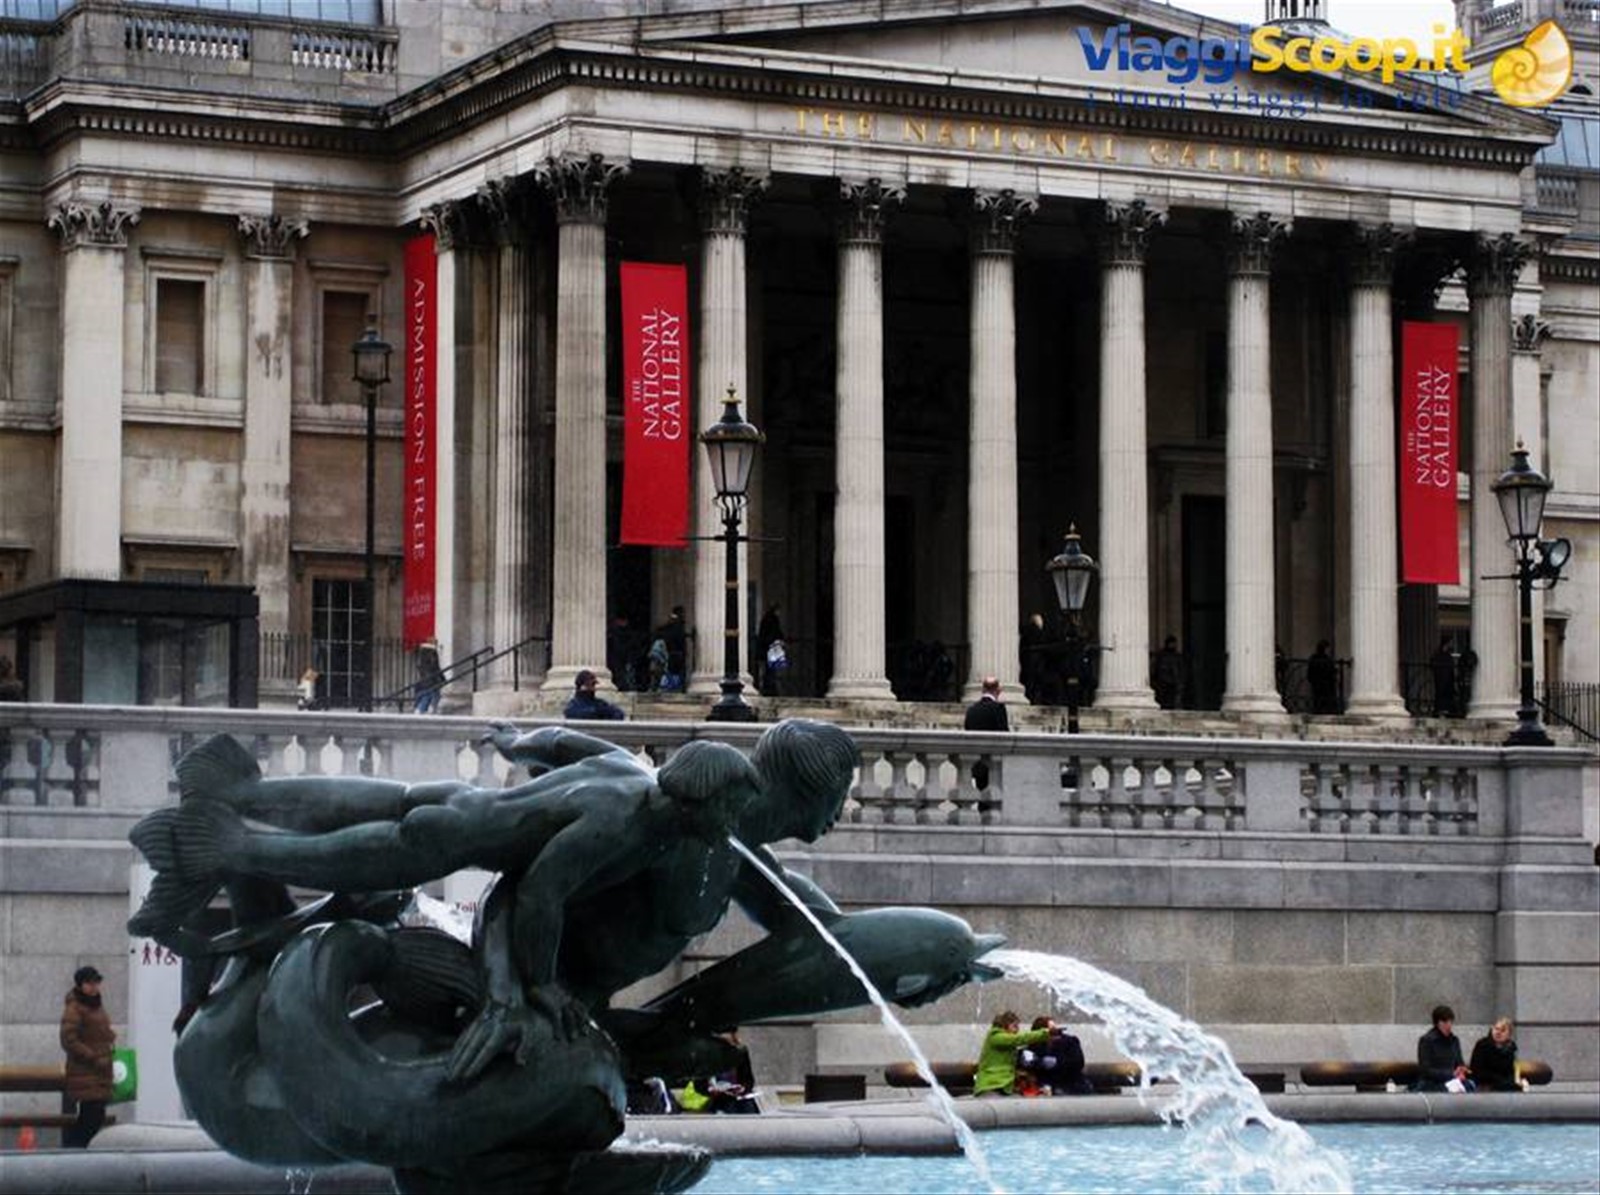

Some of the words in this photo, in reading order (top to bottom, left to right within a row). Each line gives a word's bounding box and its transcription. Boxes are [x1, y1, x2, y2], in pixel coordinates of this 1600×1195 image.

[794, 107, 876, 138] THE
[903, 113, 1121, 163] NATIONAL
[1148, 139, 1328, 177] GALLERY
[413, 278, 427, 465] ADMISSION
[642, 307, 660, 438] NATIONAL
[660, 309, 681, 441] GALLERY
[1416, 366, 1433, 486] NATIONAL
[1433, 365, 1452, 488] GALLERY
[411, 477, 426, 561] FREE
